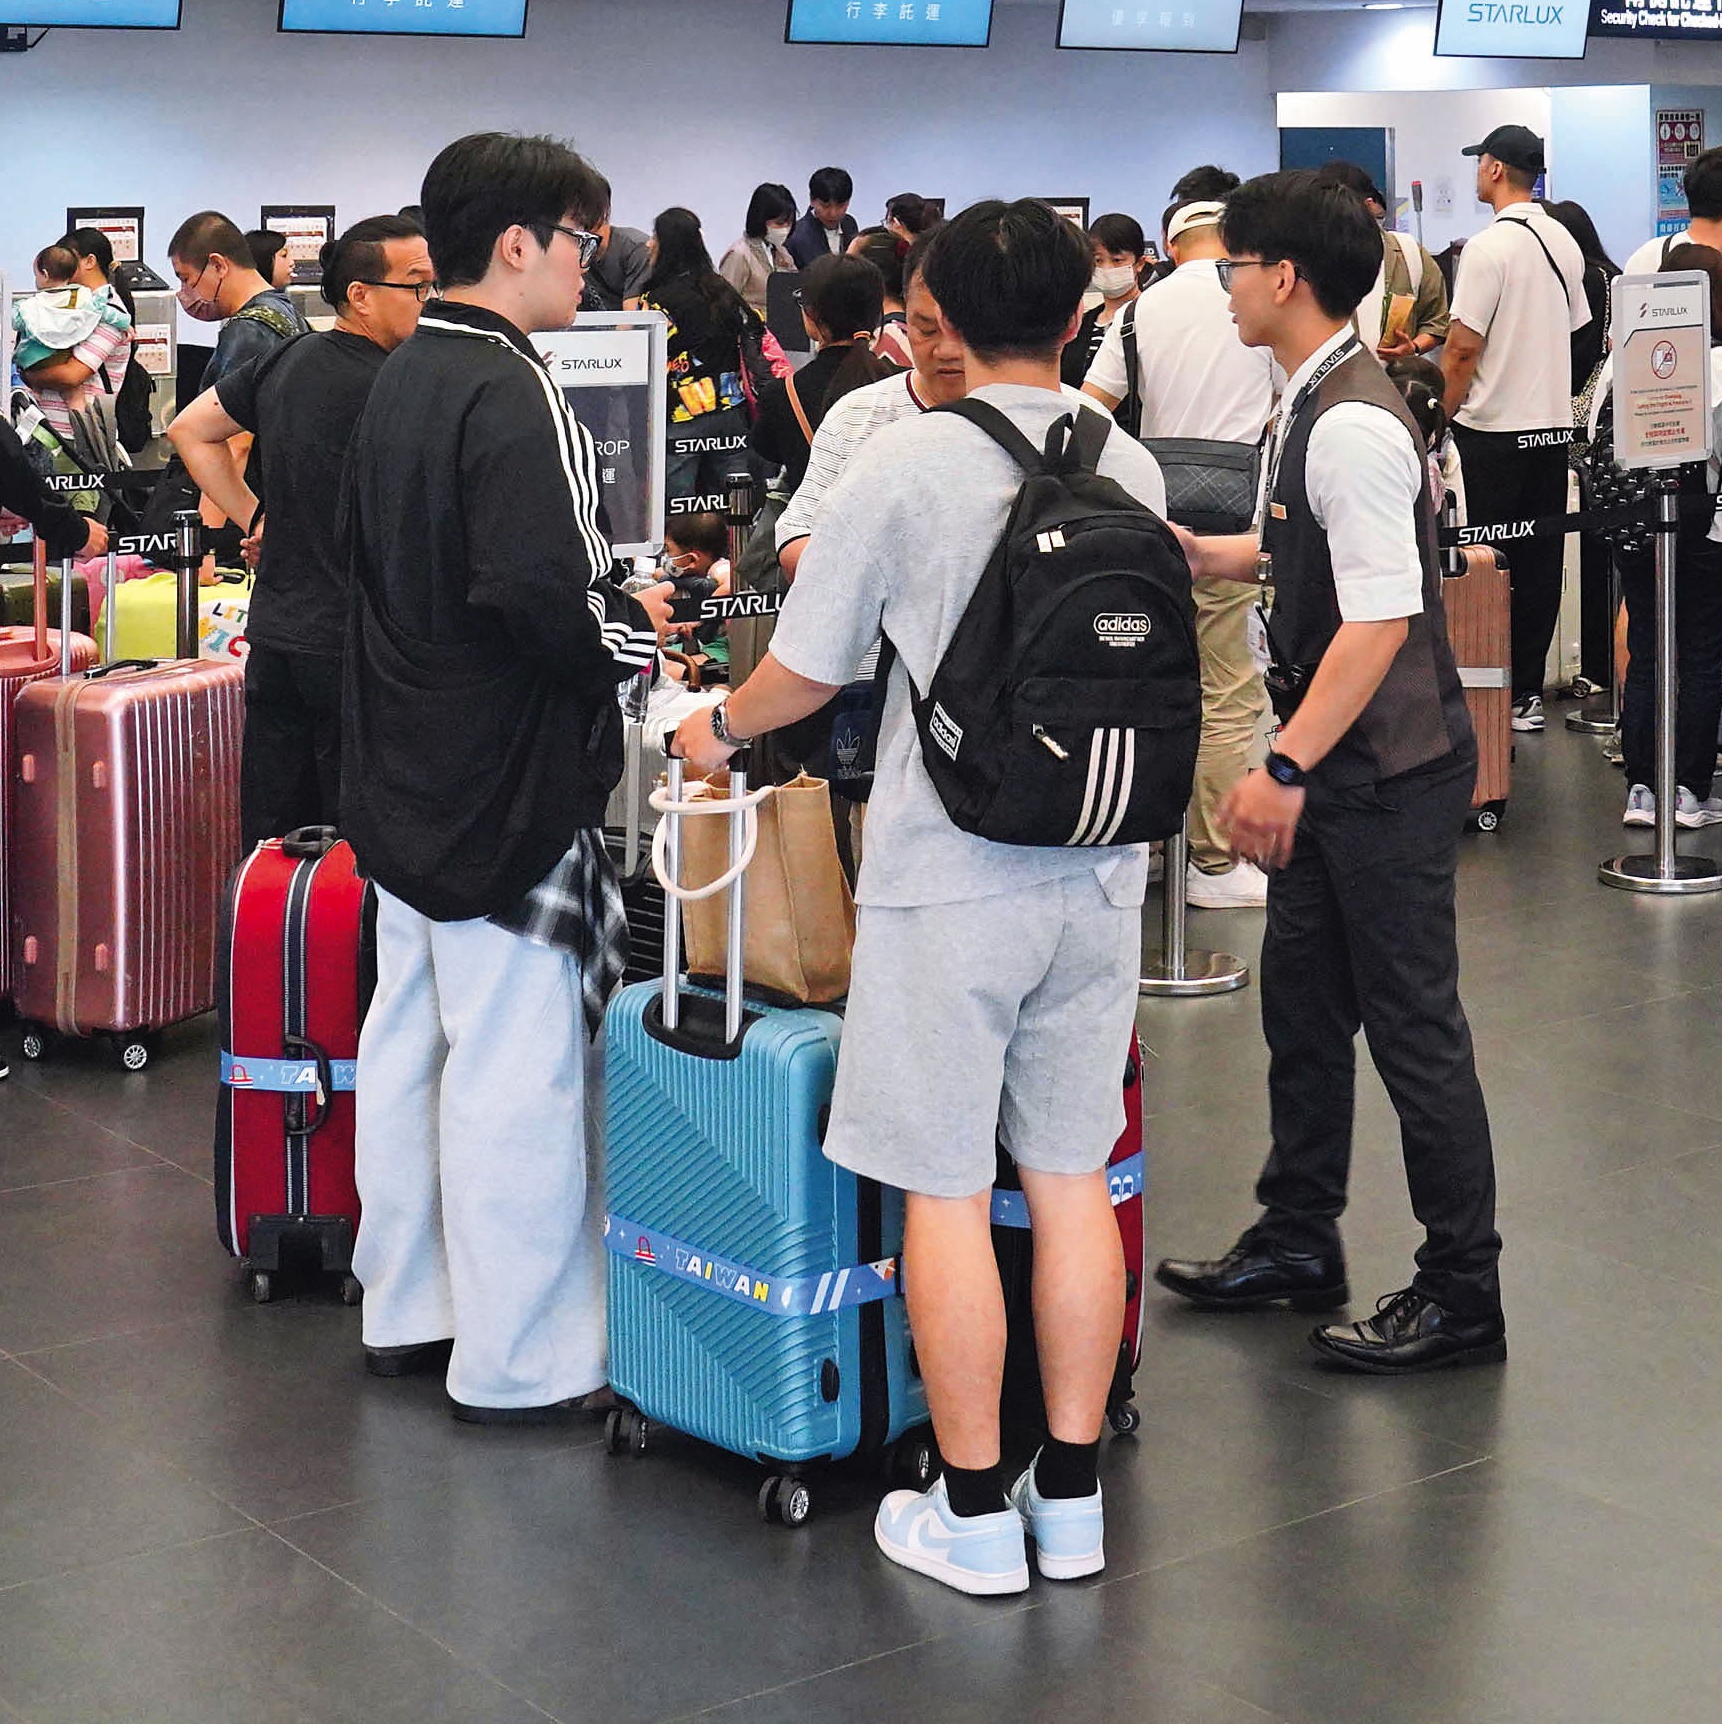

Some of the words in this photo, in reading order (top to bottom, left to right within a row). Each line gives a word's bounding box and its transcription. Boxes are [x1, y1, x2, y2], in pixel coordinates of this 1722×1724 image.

[1467, 4, 1563, 24] STARLUX
[1601, 9, 1638, 29] Security
[1638, 12, 1667, 27] Check
[1652, 307, 1688, 317] STARLUX
[561, 358, 622, 370] STARLUX
[675, 435, 748, 453] STARLUX
[1518, 430, 1574, 449] STARLUX
[1458, 520, 1535, 544] STARLUX
[1097, 615, 1148, 632] adidas
[675, 1248, 770, 1303] TAIWAN
